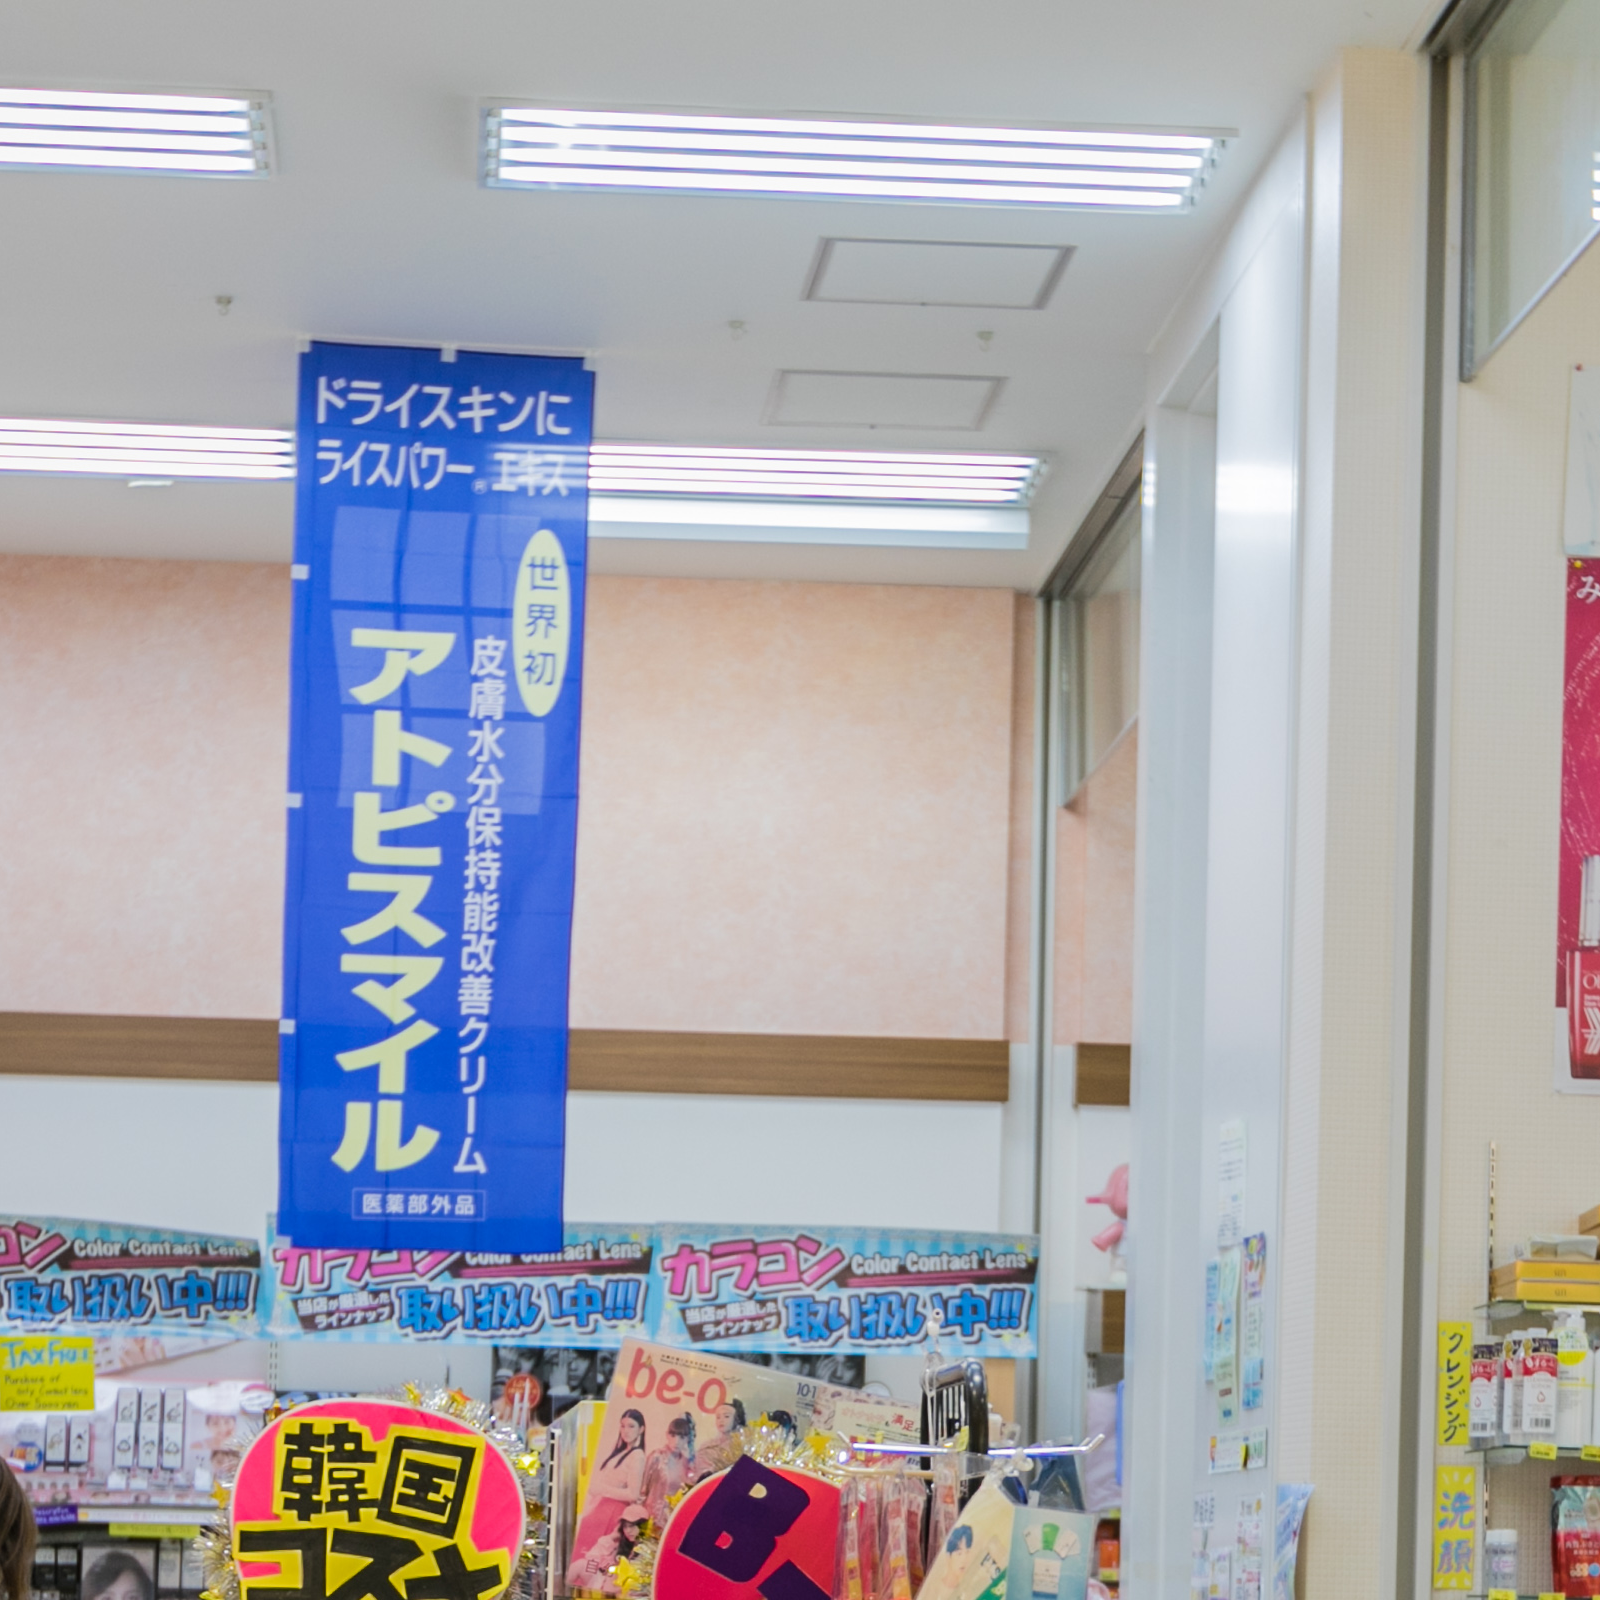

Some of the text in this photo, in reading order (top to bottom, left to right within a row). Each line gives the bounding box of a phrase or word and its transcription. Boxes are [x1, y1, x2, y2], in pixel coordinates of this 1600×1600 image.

[316, 375, 573, 437] ドライスキンに
[522, 554, 561, 687] 世界初
[330, 628, 457, 1172] アトピスマイル
[454, 636, 509, 1174] 皮膚水分保持能改善クリーム
[362, 1193, 476, 1215] 医薬部外品
[72, 1236, 249, 1259] Color Contact Lens
[661, 1234, 847, 1296] カラコン
[850, 1248, 1027, 1276] Color Contact Lens
[3, 1272, 257, 1326] 取り扱い中!!!
[398, 1279, 639, 1334] 取り扱い中!!!
[1440, 1328, 1469, 1444] クレンジング
[280, 1423, 478, 1541] 韓国
[1436, 1491, 1476, 1575] 洗顔
